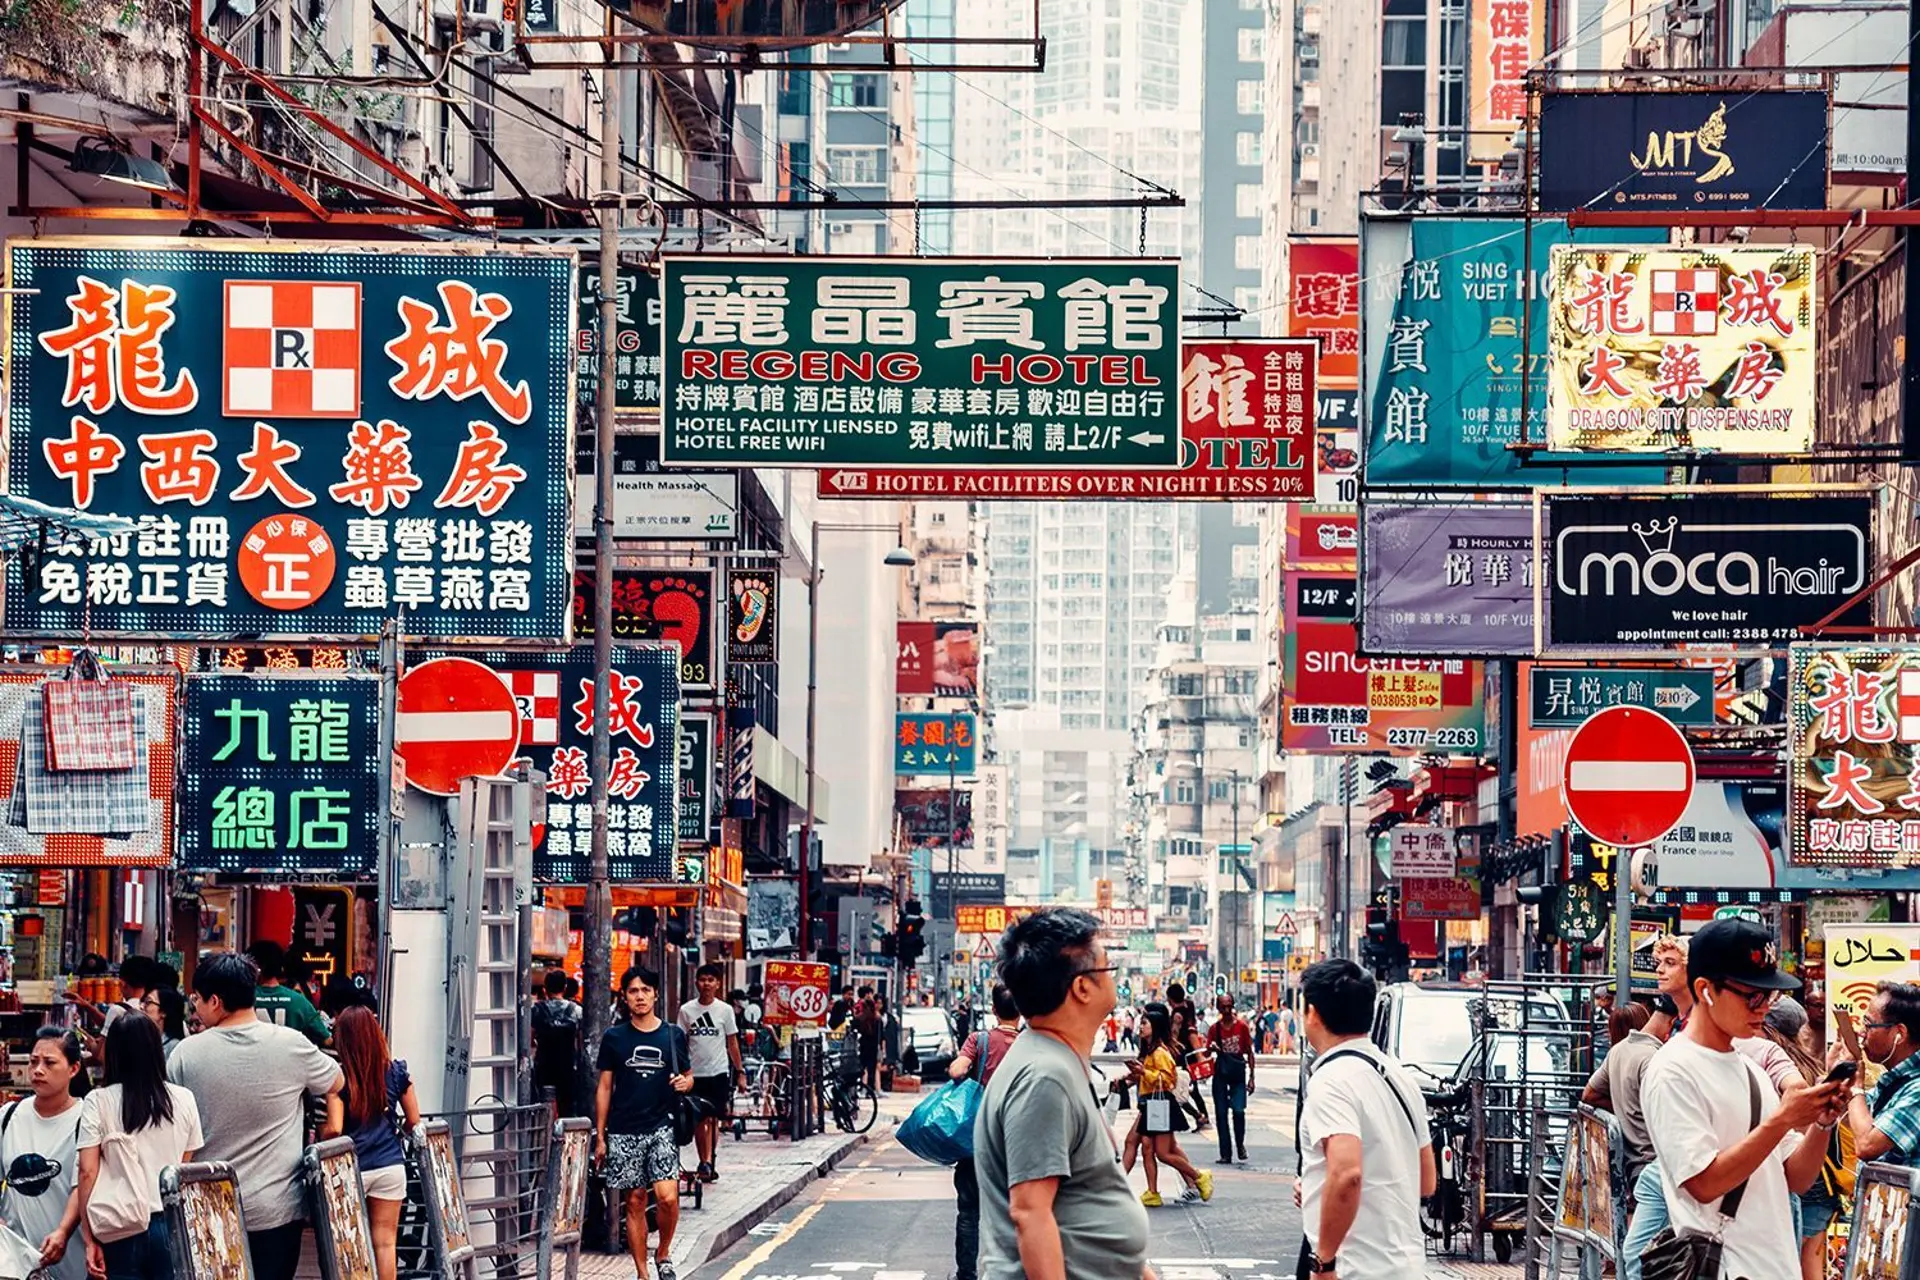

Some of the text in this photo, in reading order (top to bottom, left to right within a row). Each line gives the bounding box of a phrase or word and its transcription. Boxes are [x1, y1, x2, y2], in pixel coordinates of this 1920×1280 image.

[1630, 100, 1735, 183] MTS
[1462, 262, 1508, 279] SING
[1462, 283, 1508, 300] YUET
[677, 274, 1170, 352] 麗晶賓館
[1723, 268, 1795, 338] 城
[39, 276, 199, 416] 龍
[388, 280, 533, 426] 城
[681, 349, 1161, 387] REGENG HOTEL
[1578, 341, 1786, 404] 大藥房
[675, 383, 1166, 418] 持牌賓館 酒店設備 豪華套房 歡迎自由行
[675, 417, 899, 435] HOTEL FACILITY LIENSED
[1462, 424, 1490, 436] 10/F
[1568, 408, 1645, 432] DRAGON
[1646, 408, 1685, 432] CITY
[1688, 408, 1794, 432] DISPENSARY
[675, 434, 826, 450] HOTEL FREE WIFI
[1044, 422, 1123, 452] 請上2/F
[43, 415, 528, 516] 中西大藥房
[616, 481, 708, 492] Health Massage
[839, 473, 1305, 494] 1/F HOTEL FACILITEIS OVER NIGHT LESS 20%
[709, 514, 729, 524] 1/F
[345, 517, 534, 565] 專營批發
[1471, 538, 1520, 549] HOURLY
[261, 553, 312, 600] 正
[1580, 549, 1845, 596] moca hair
[343, 566, 532, 612] 蟲草燕窩
[1301, 589, 1340, 606] 12/F
[1484, 614, 1508, 626] 10/F
[1671, 609, 1748, 621] We love hair
[1617, 628, 1700, 642] appointment
[1702, 628, 1731, 640] call:
[1733, 628, 1769, 640] 2388
[1370, 694, 1418, 707] 60380538
[1571, 706, 1589, 715] SING
[212, 698, 350, 762] 九龍
[1329, 727, 1478, 746] TEL: 2377-2263
[211, 786, 350, 850] 總店
[1662, 845, 1697, 856] France
[1833, 937, 1906, 967] حلال
